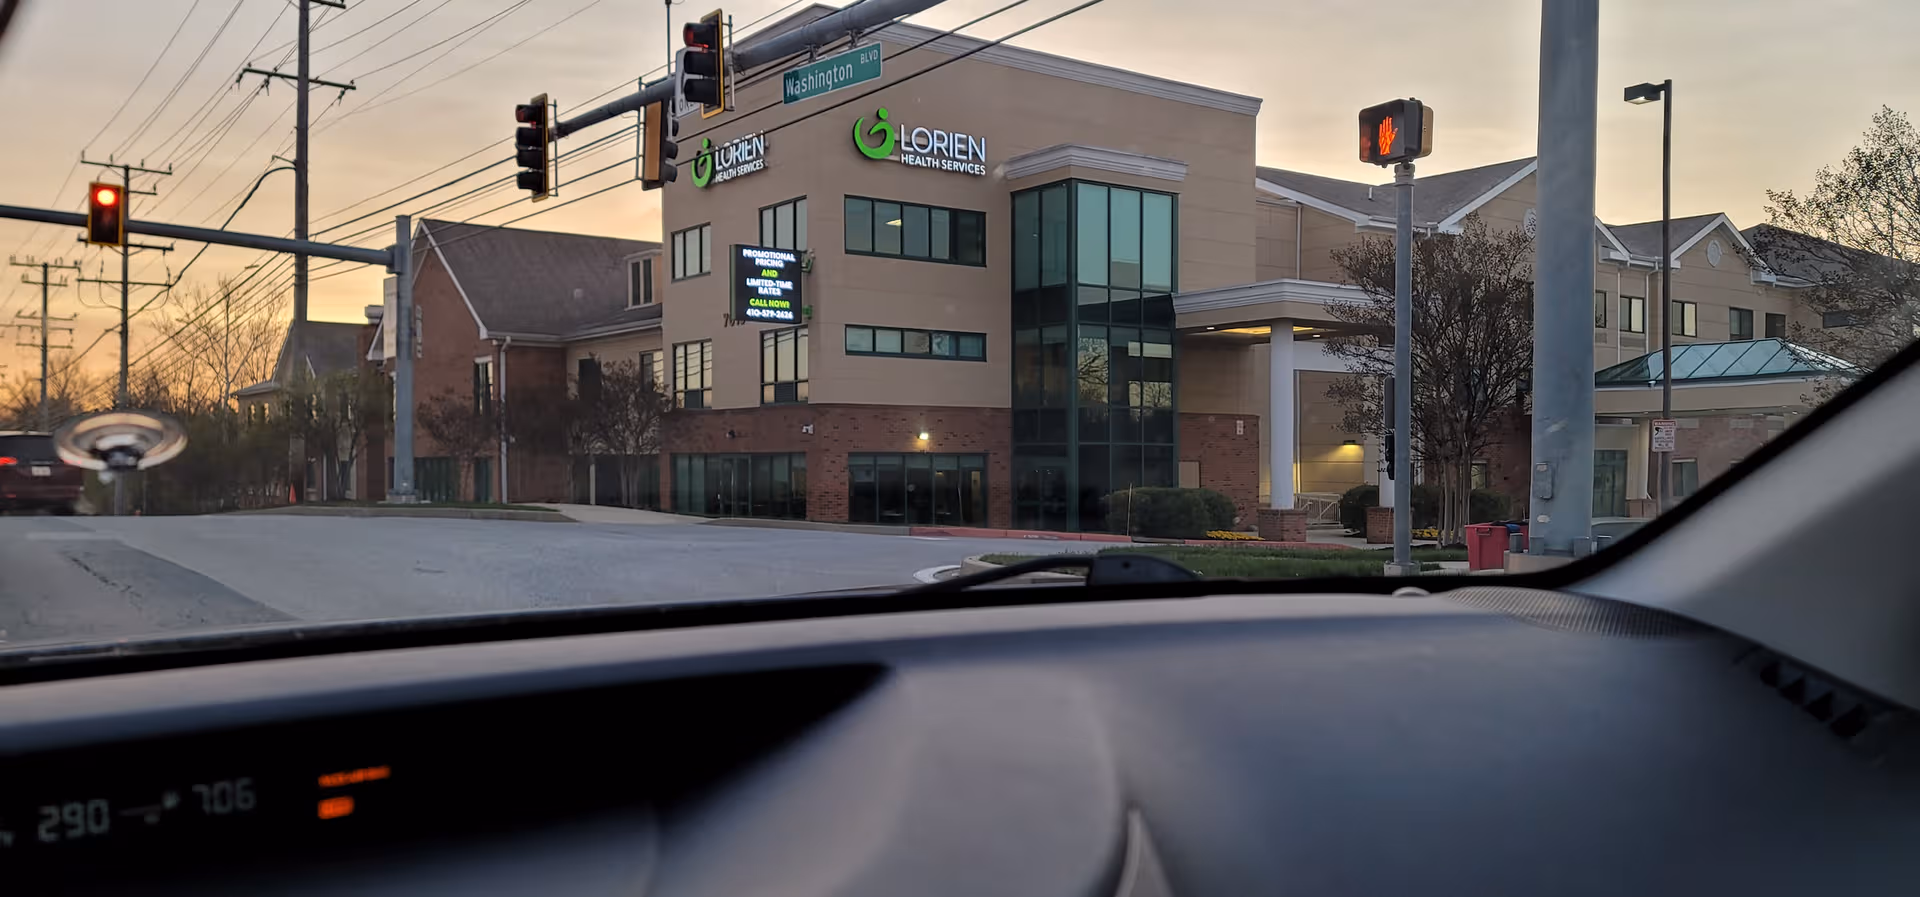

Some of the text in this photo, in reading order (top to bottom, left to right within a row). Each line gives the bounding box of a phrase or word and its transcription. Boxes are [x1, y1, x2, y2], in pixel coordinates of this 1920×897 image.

[785, 49, 879, 97] Washington BLVD
[715, 129, 765, 171] LORIEN
[901, 123, 986, 163] LORIEN
[715, 158, 765, 183] HEALTH SERVICES
[901, 153, 986, 176] HEALTH SERVICES
[742, 248, 796, 262] PROMOTIONAL
[755, 258, 784, 269] PRICING
[761, 269, 779, 278] AND
[746, 278, 793, 290] LIMITED-TIME
[758, 287, 782, 297] RATES
[749, 298, 790, 309] CALL NOW!
[38, 798, 110, 843] 290
